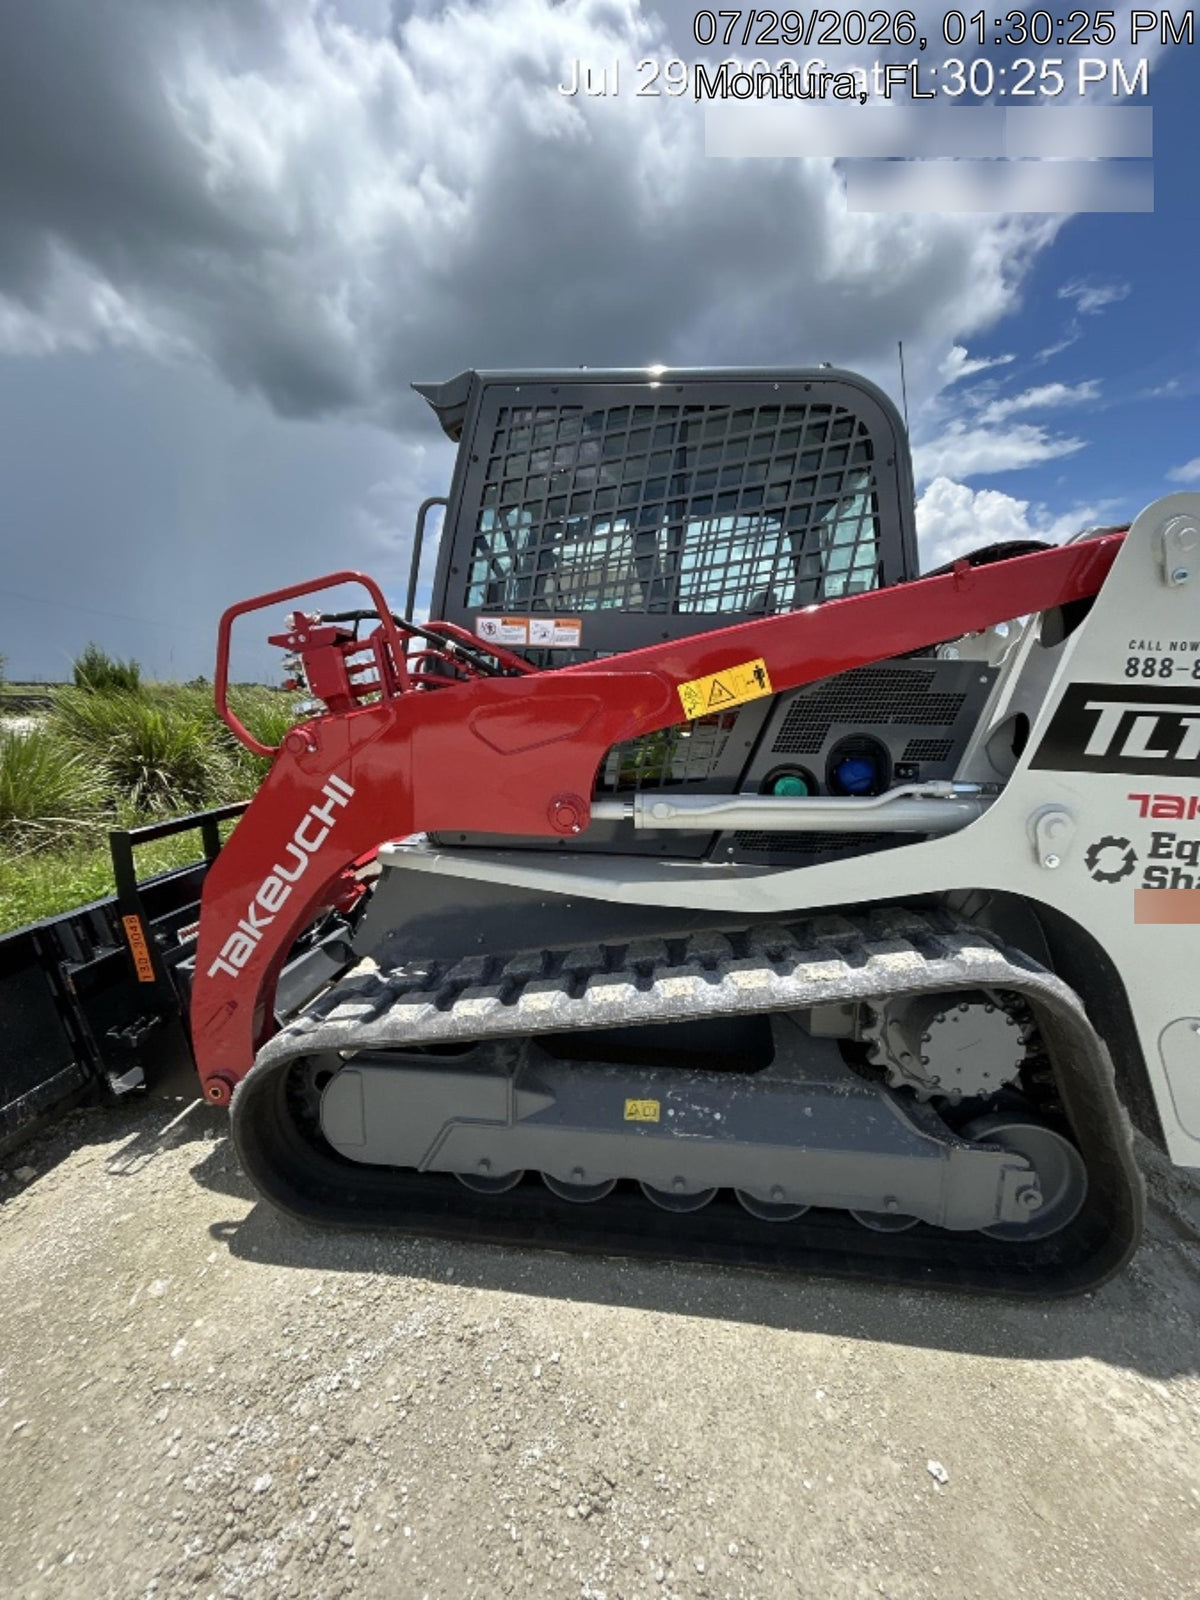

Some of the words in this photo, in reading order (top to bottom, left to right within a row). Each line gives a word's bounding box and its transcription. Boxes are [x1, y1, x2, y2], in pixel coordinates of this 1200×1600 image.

[1128, 639, 1162, 652] CALL
[1169, 641, 1200, 652] NOW
[1124, 656, 1200, 680] 888-8
[1141, 865, 1200, 890] Sh
